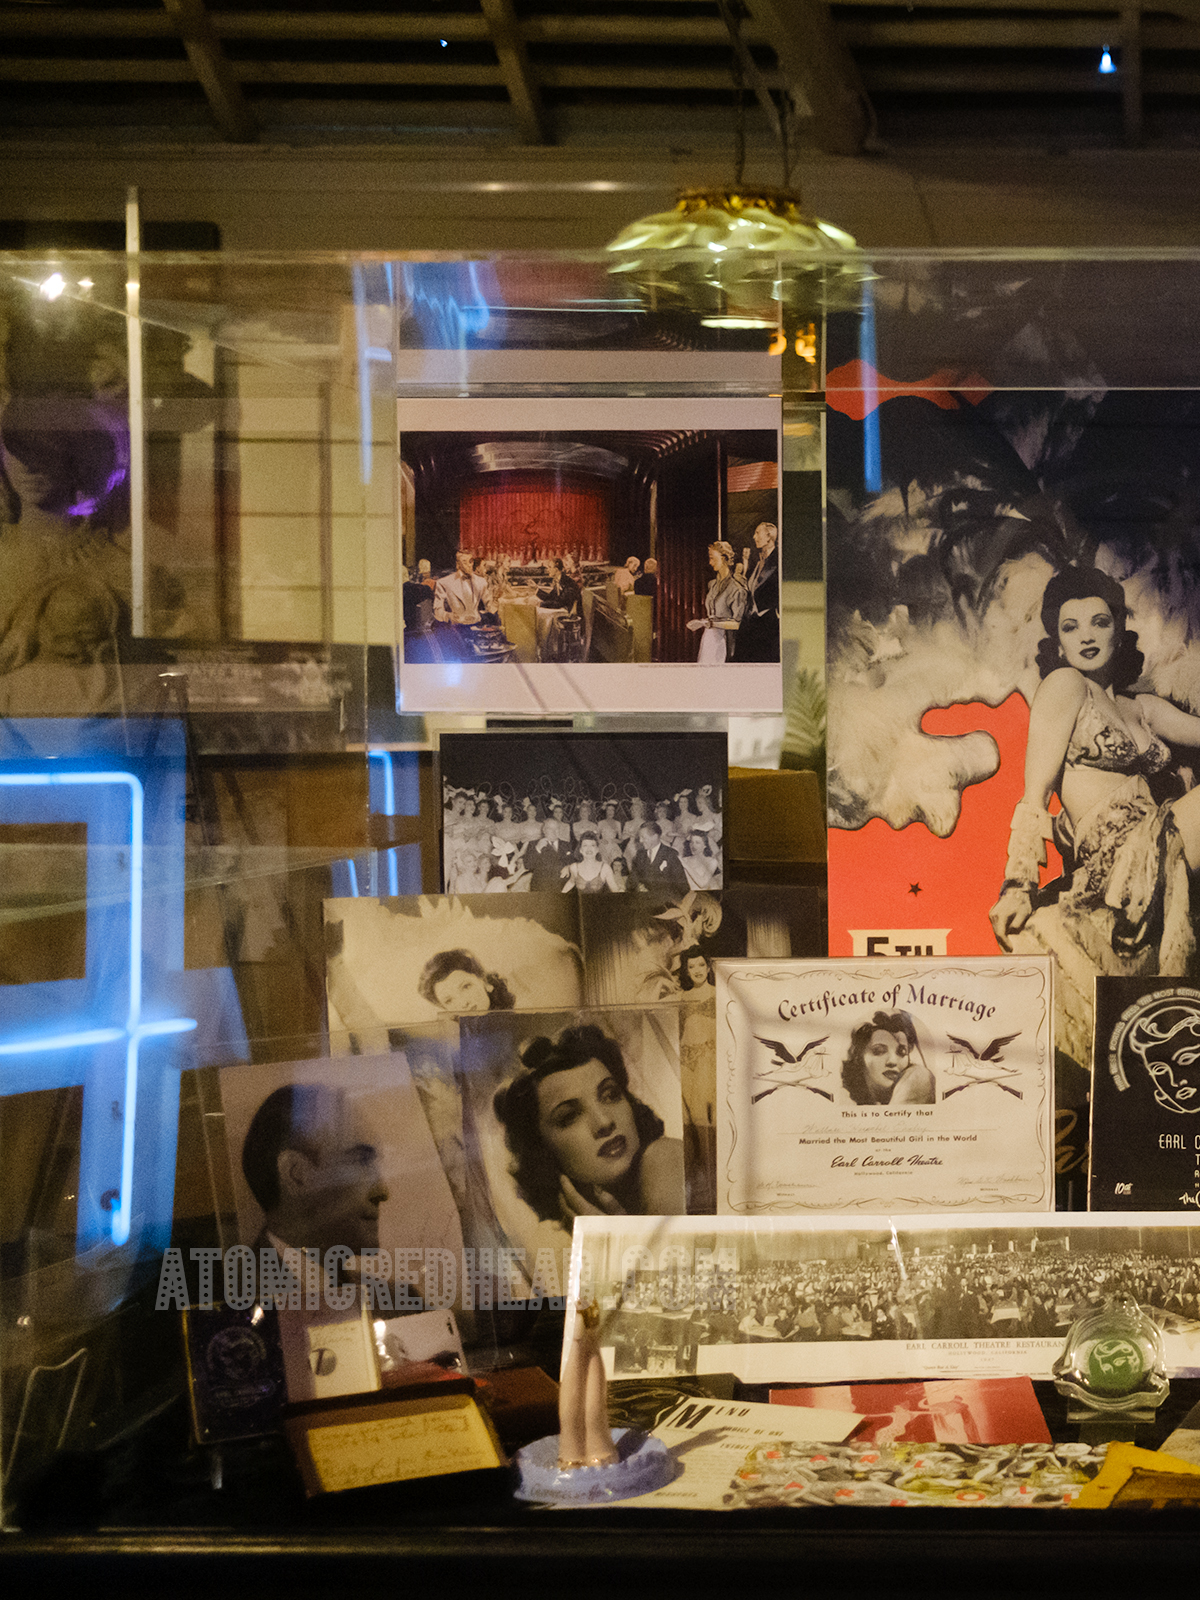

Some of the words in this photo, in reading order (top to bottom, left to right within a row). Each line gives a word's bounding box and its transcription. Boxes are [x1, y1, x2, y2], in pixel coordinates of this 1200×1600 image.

[777, 988, 875, 1021] Certificate
[882, 983, 901, 1008] of
[906, 983, 996, 1022] Marriage
[1108, 1021, 1126, 1051] PORTALS
[1120, 1004, 1141, 1022] PASS
[1136, 994, 1153, 1006] THE
[1152, 988, 1175, 999] MOST
[884, 1110, 912, 1119] Certify
[1159, 1134, 1187, 1149] EARL
[830, 1155, 859, 1168] Earl
[861, 1155, 905, 1167] Carroll
[907, 1154, 943, 1166] Theatre
[931, 1342, 969, 1350] CARROLL
[974, 1341, 1011, 1349] THEATRE
[666, 1404, 751, 1429] MENU
